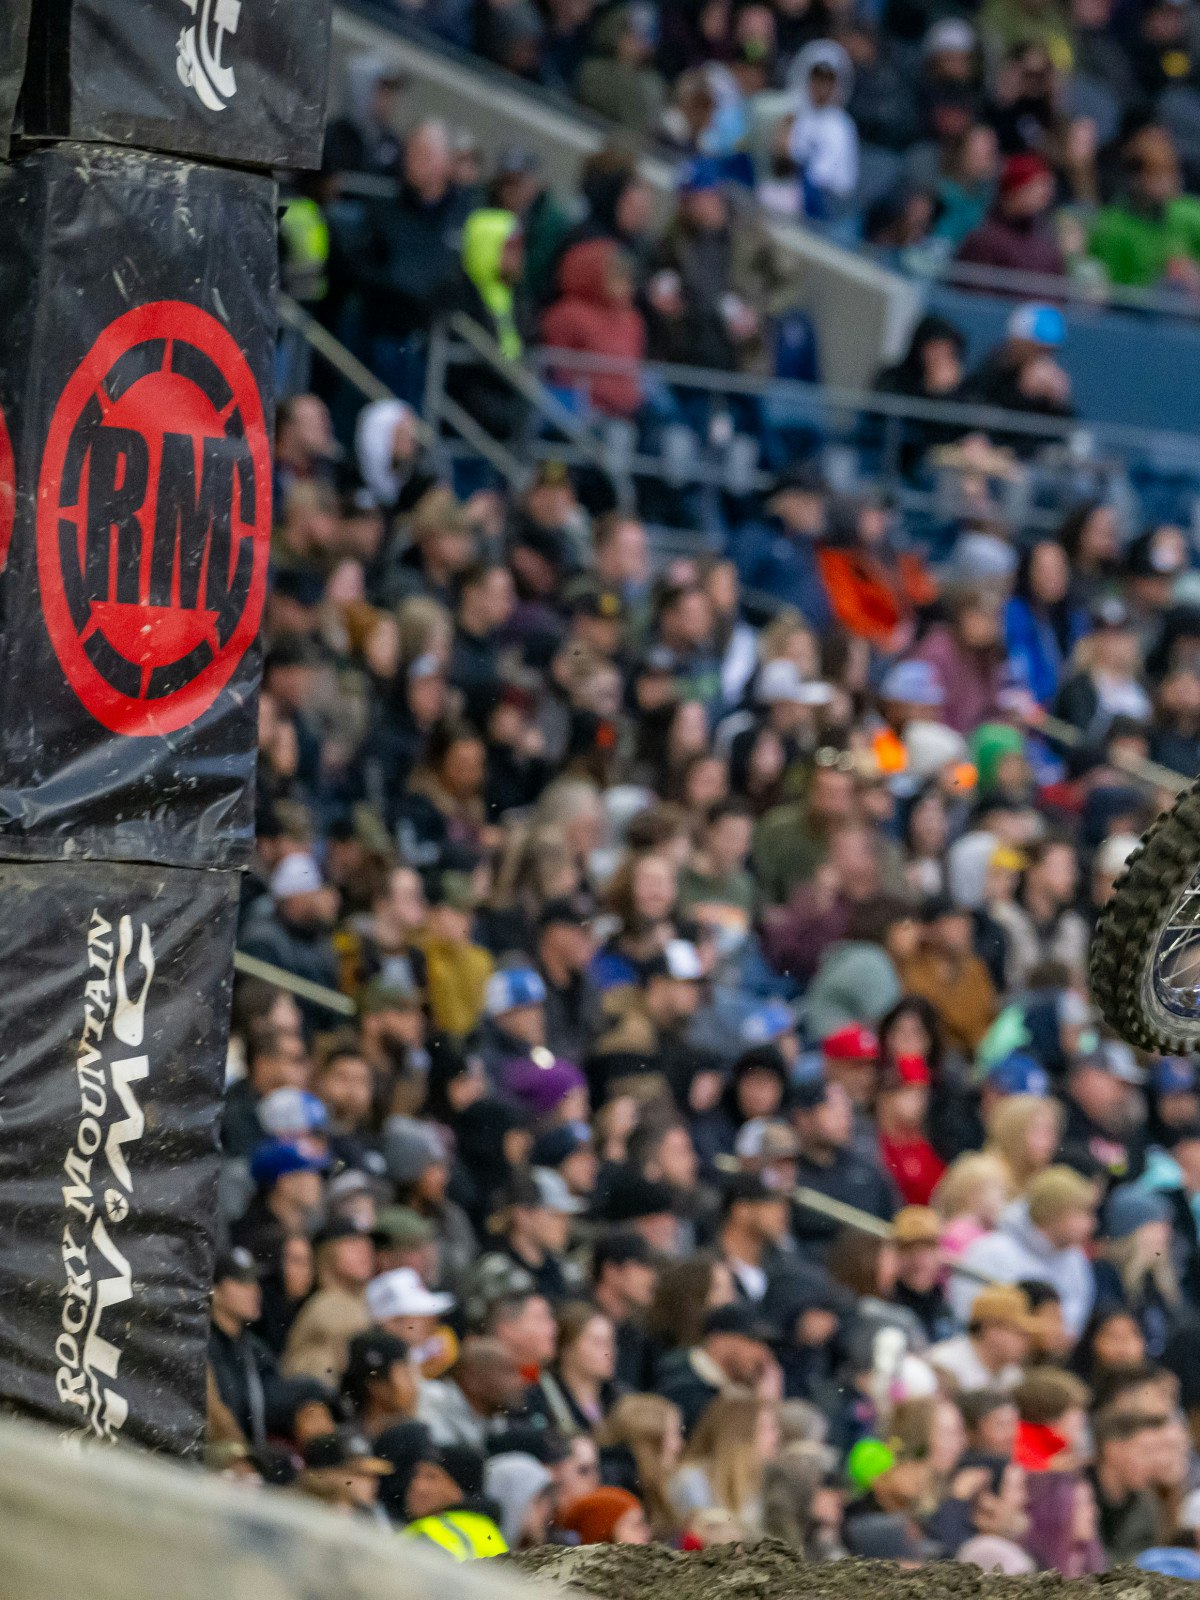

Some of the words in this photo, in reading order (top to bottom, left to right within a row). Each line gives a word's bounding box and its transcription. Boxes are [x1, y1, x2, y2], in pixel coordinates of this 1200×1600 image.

[86, 425, 245, 612] RM
[62, 908, 116, 1223] MOUNTAIN
[56, 1229, 90, 1415] ROCKY
